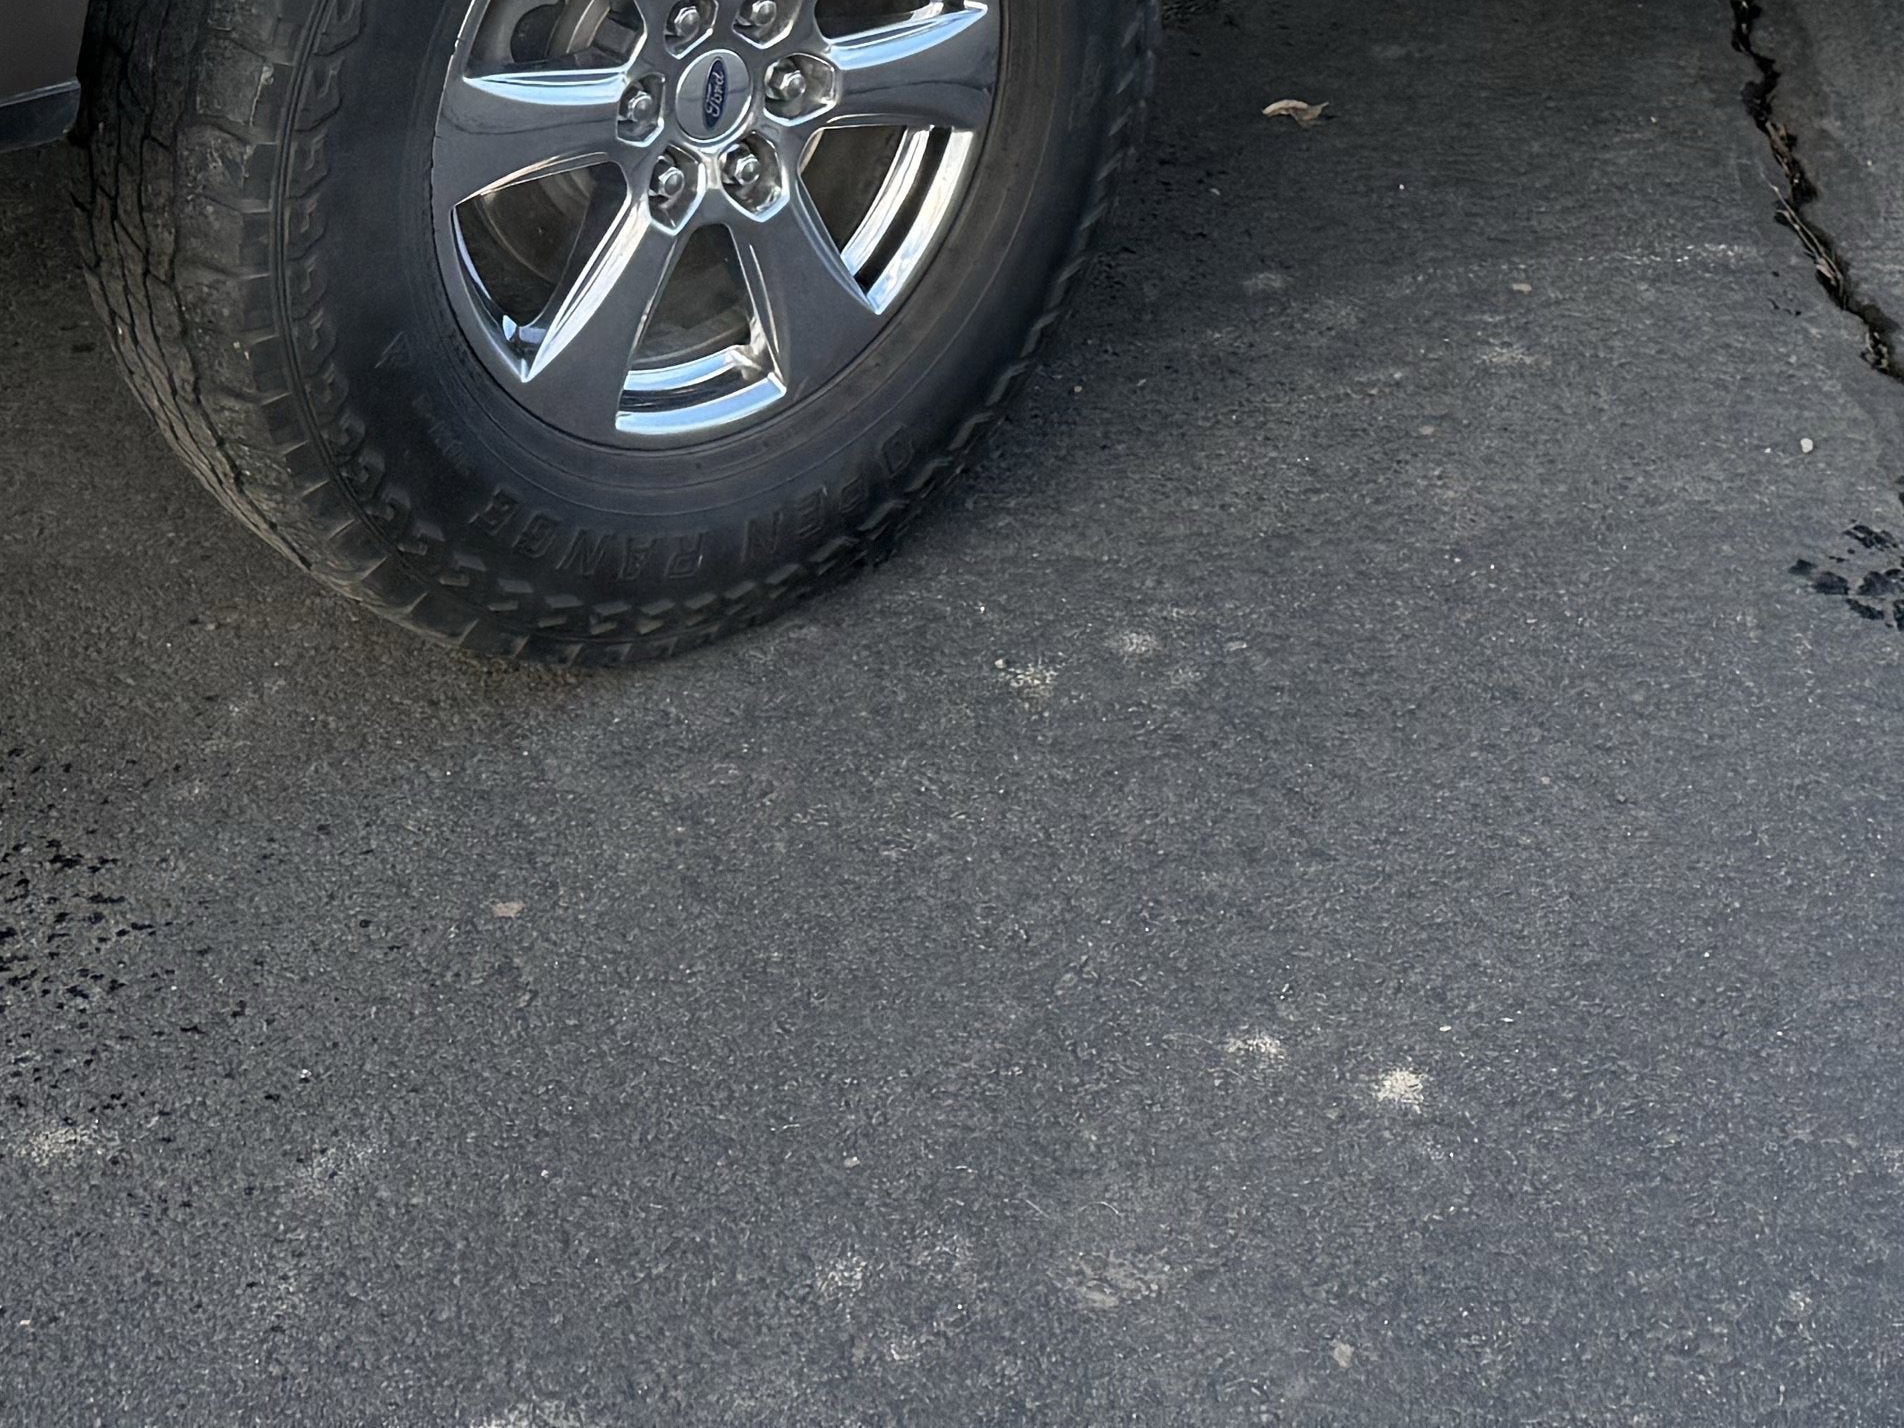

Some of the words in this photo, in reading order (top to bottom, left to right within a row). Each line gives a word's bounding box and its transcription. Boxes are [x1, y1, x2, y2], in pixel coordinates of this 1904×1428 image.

[705, 70, 725, 118] Ford
[470, 486, 705, 582] RANGE
[740, 424, 914, 563] OPEN
